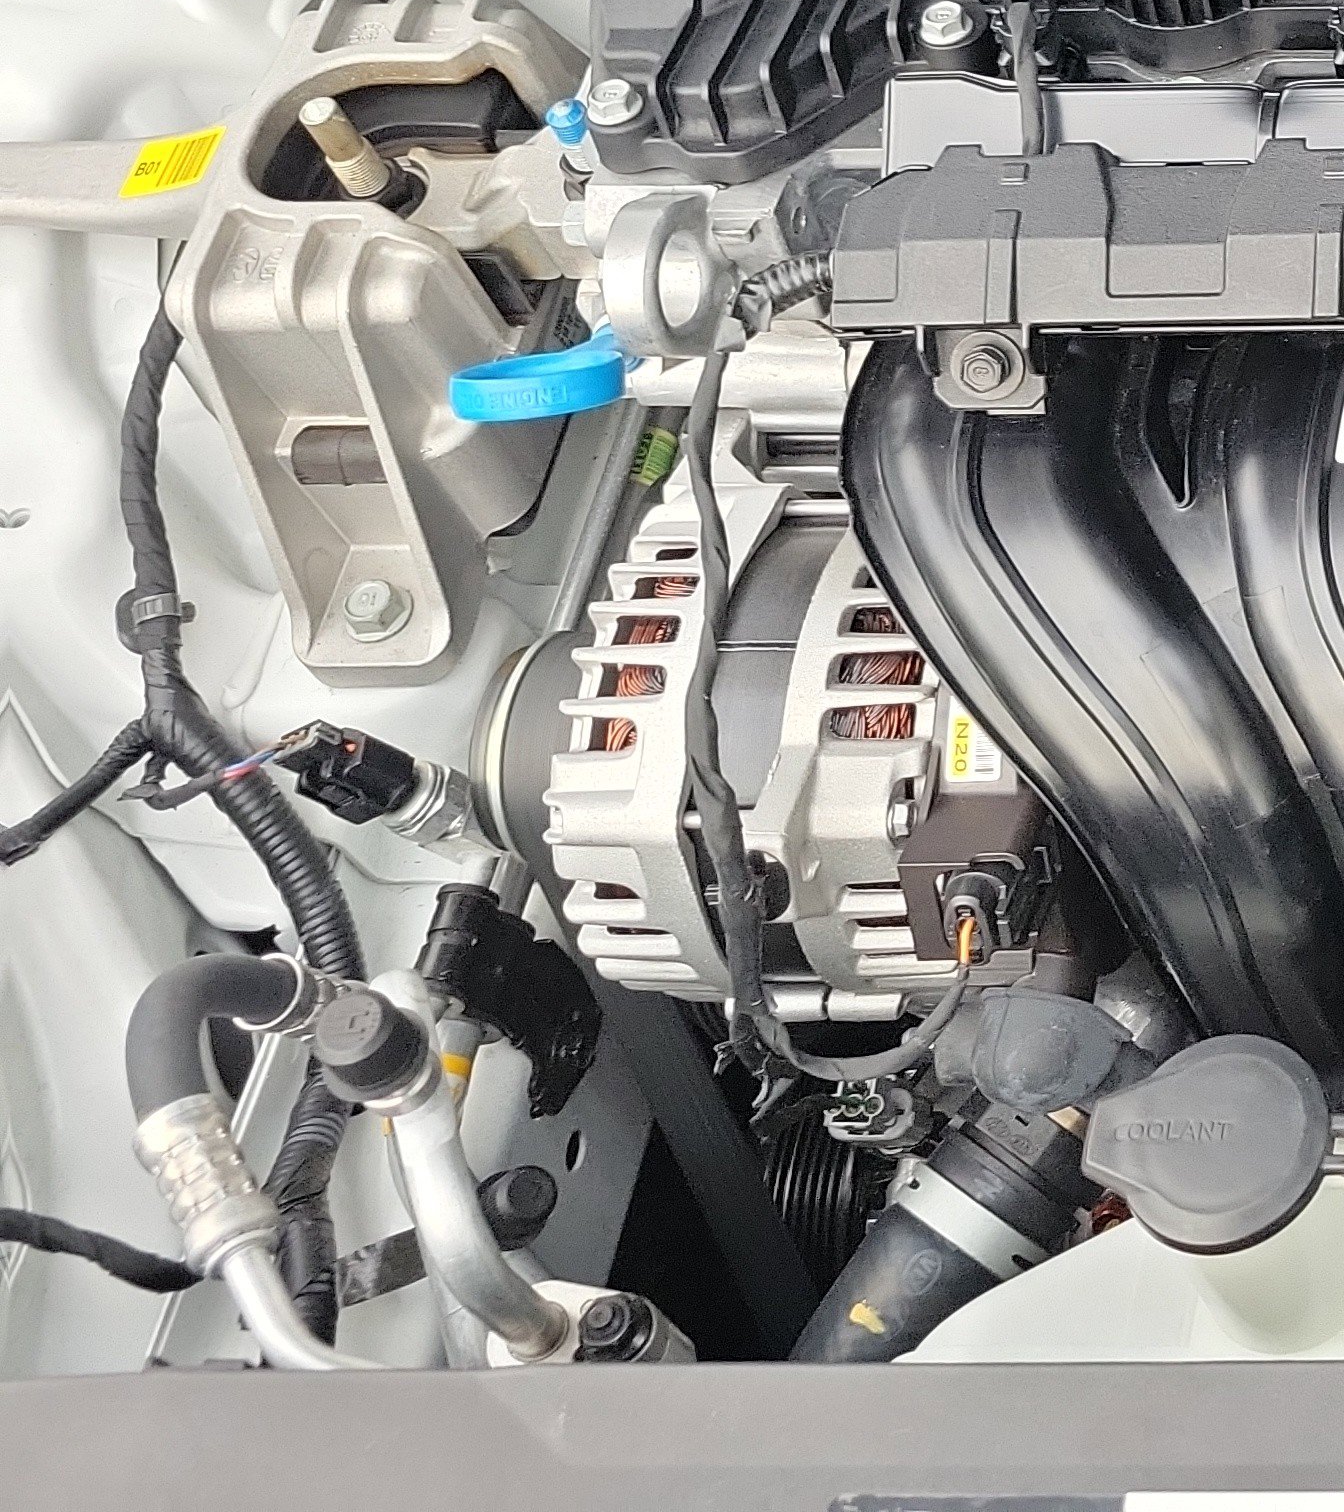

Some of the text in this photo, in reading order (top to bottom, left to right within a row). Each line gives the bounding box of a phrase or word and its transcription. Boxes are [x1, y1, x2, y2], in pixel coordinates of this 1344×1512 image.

[134, 160, 162, 177] B01
[954, 722, 970, 772] N20
[1113, 1119, 1233, 1143] COOLANT
